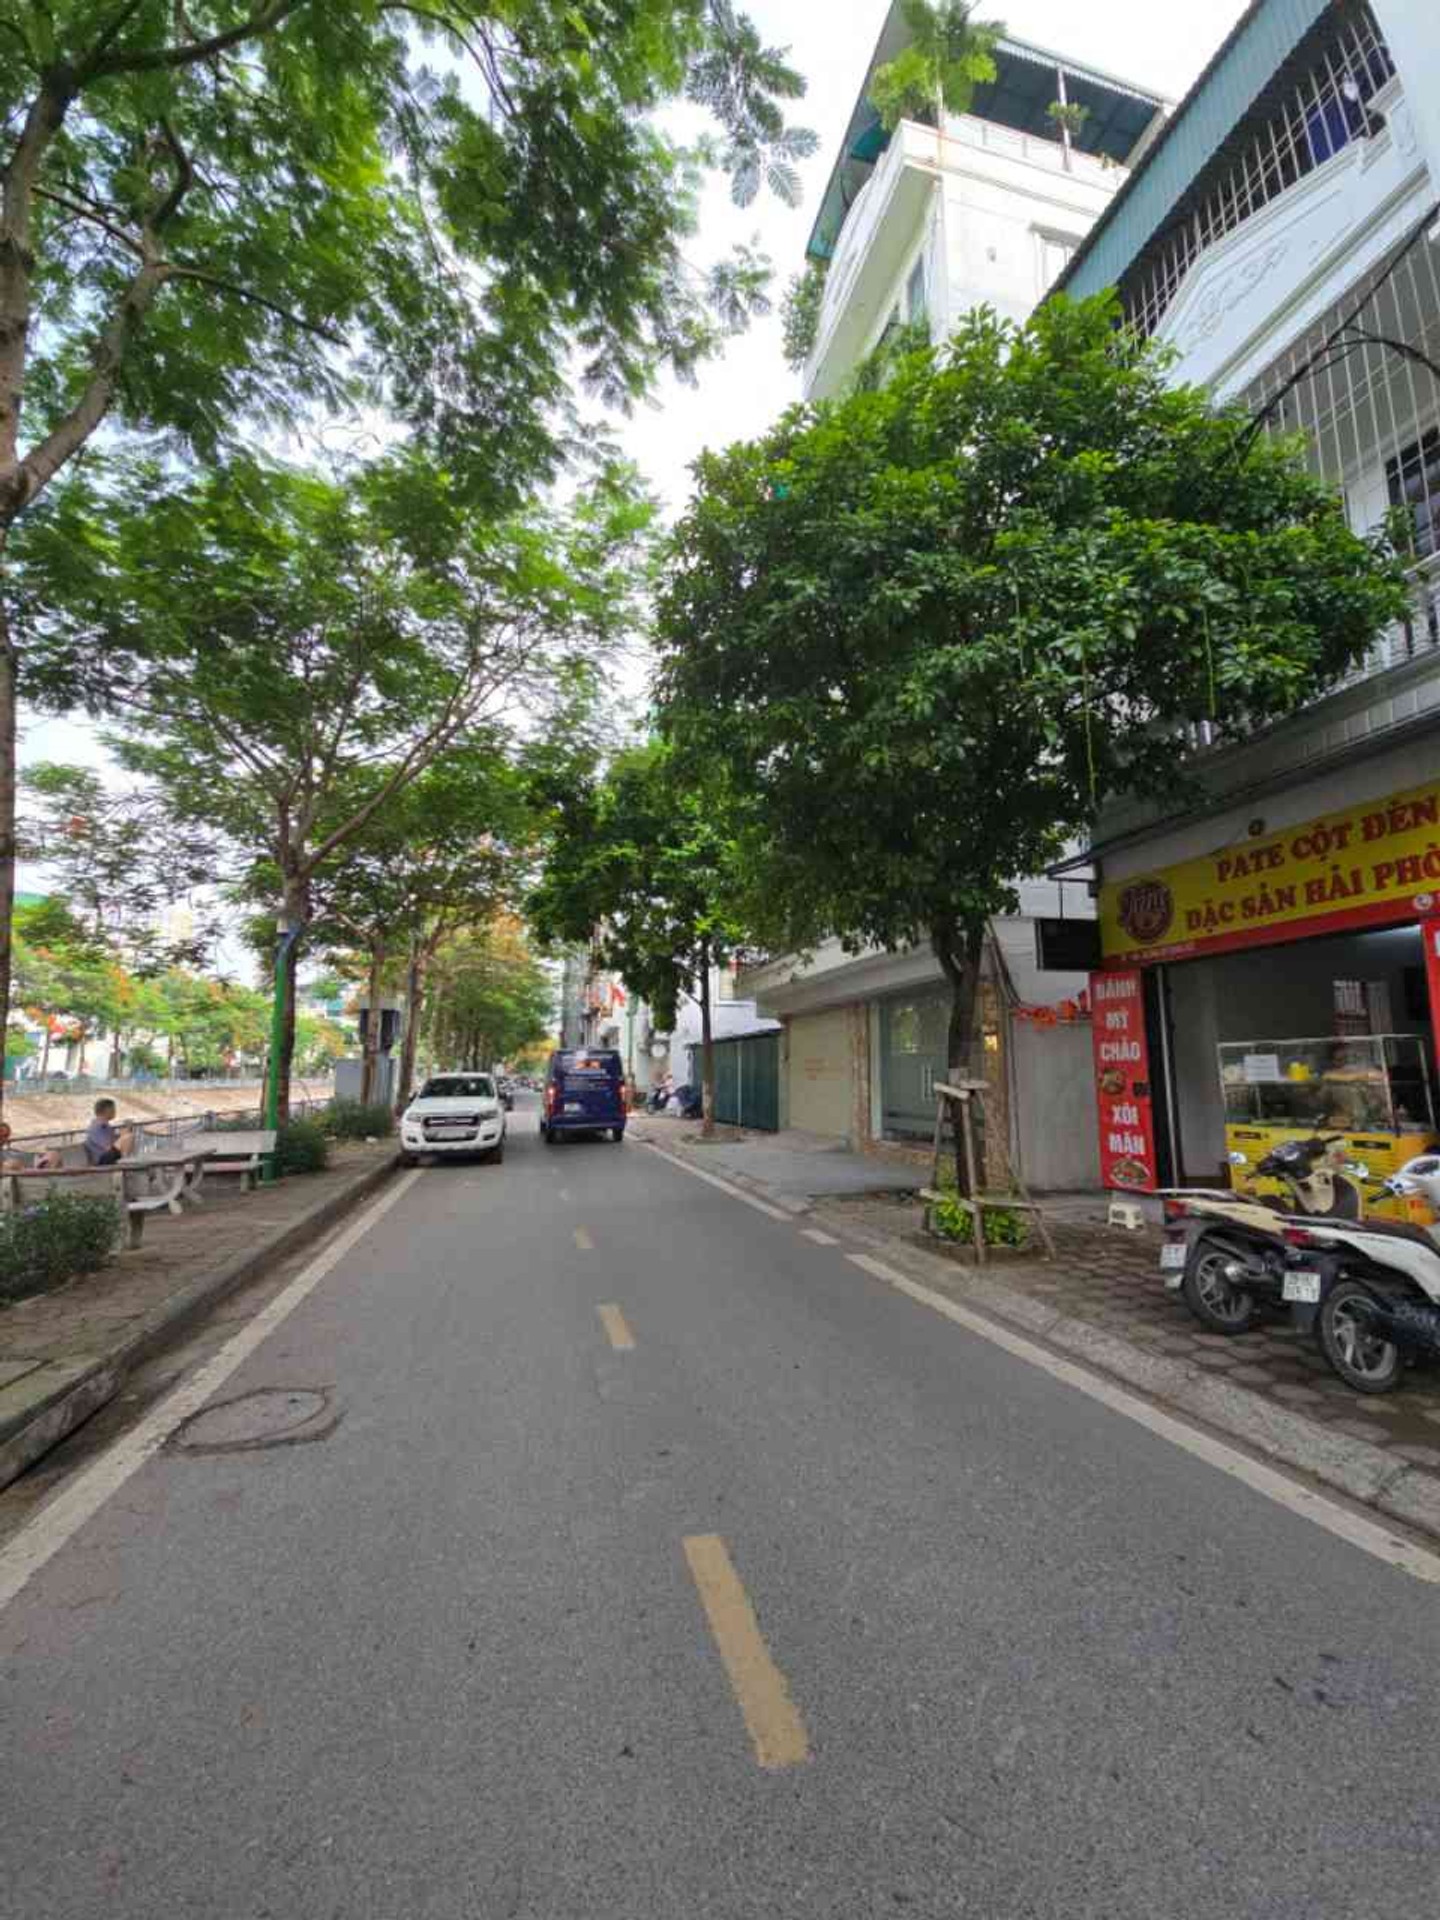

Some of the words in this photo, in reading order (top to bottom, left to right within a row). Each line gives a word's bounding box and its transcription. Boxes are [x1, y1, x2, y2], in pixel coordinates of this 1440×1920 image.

[1216, 842, 1286, 883] PATE
[1292, 818, 1354, 862] CỘT
[1361, 793, 1439, 842] ĐÈN
